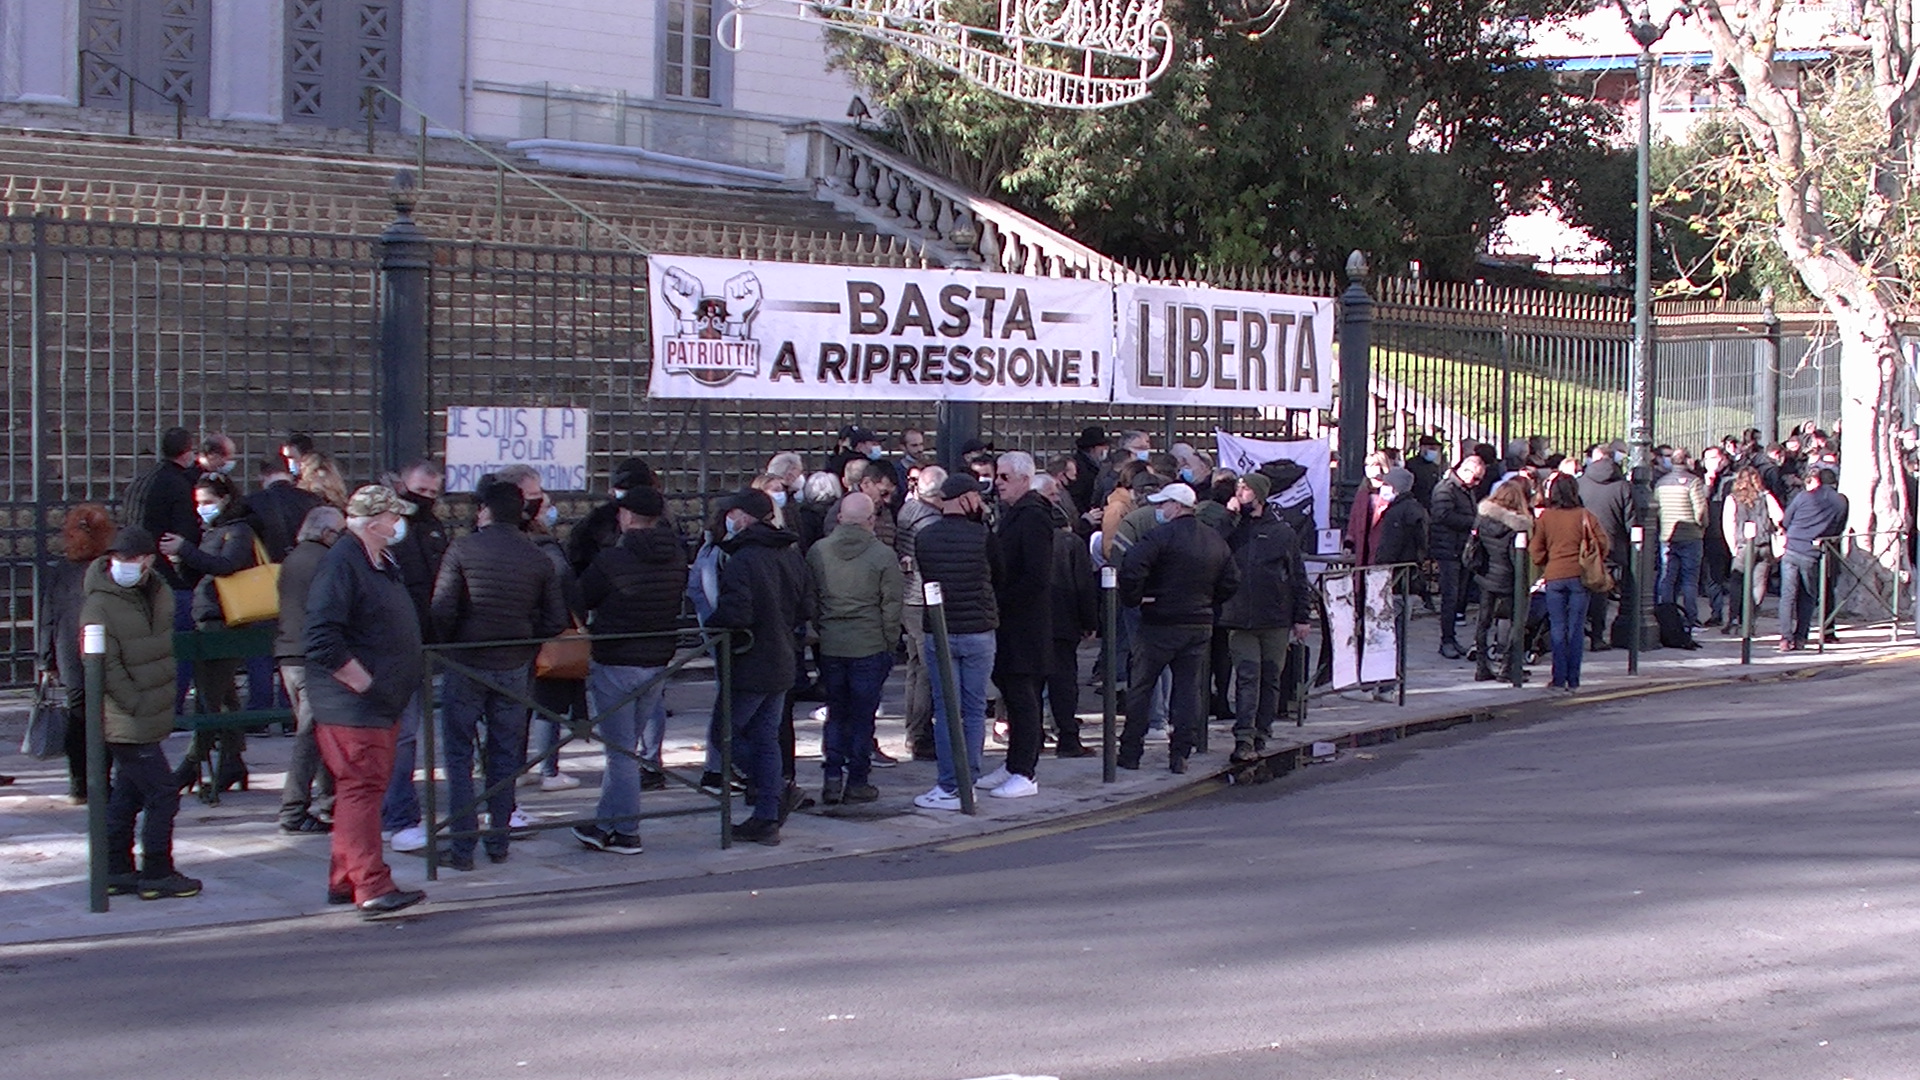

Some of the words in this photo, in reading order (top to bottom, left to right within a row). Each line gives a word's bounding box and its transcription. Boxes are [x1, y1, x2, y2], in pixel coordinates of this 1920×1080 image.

[845, 279, 1037, 341] BASTA
[667, 340, 755, 366] PATRIOTTI!
[768, 340, 803, 383] A
[446, 407, 469, 437] JE
[476, 408, 528, 438] SUIS
[499, 438, 556, 461] POUR
